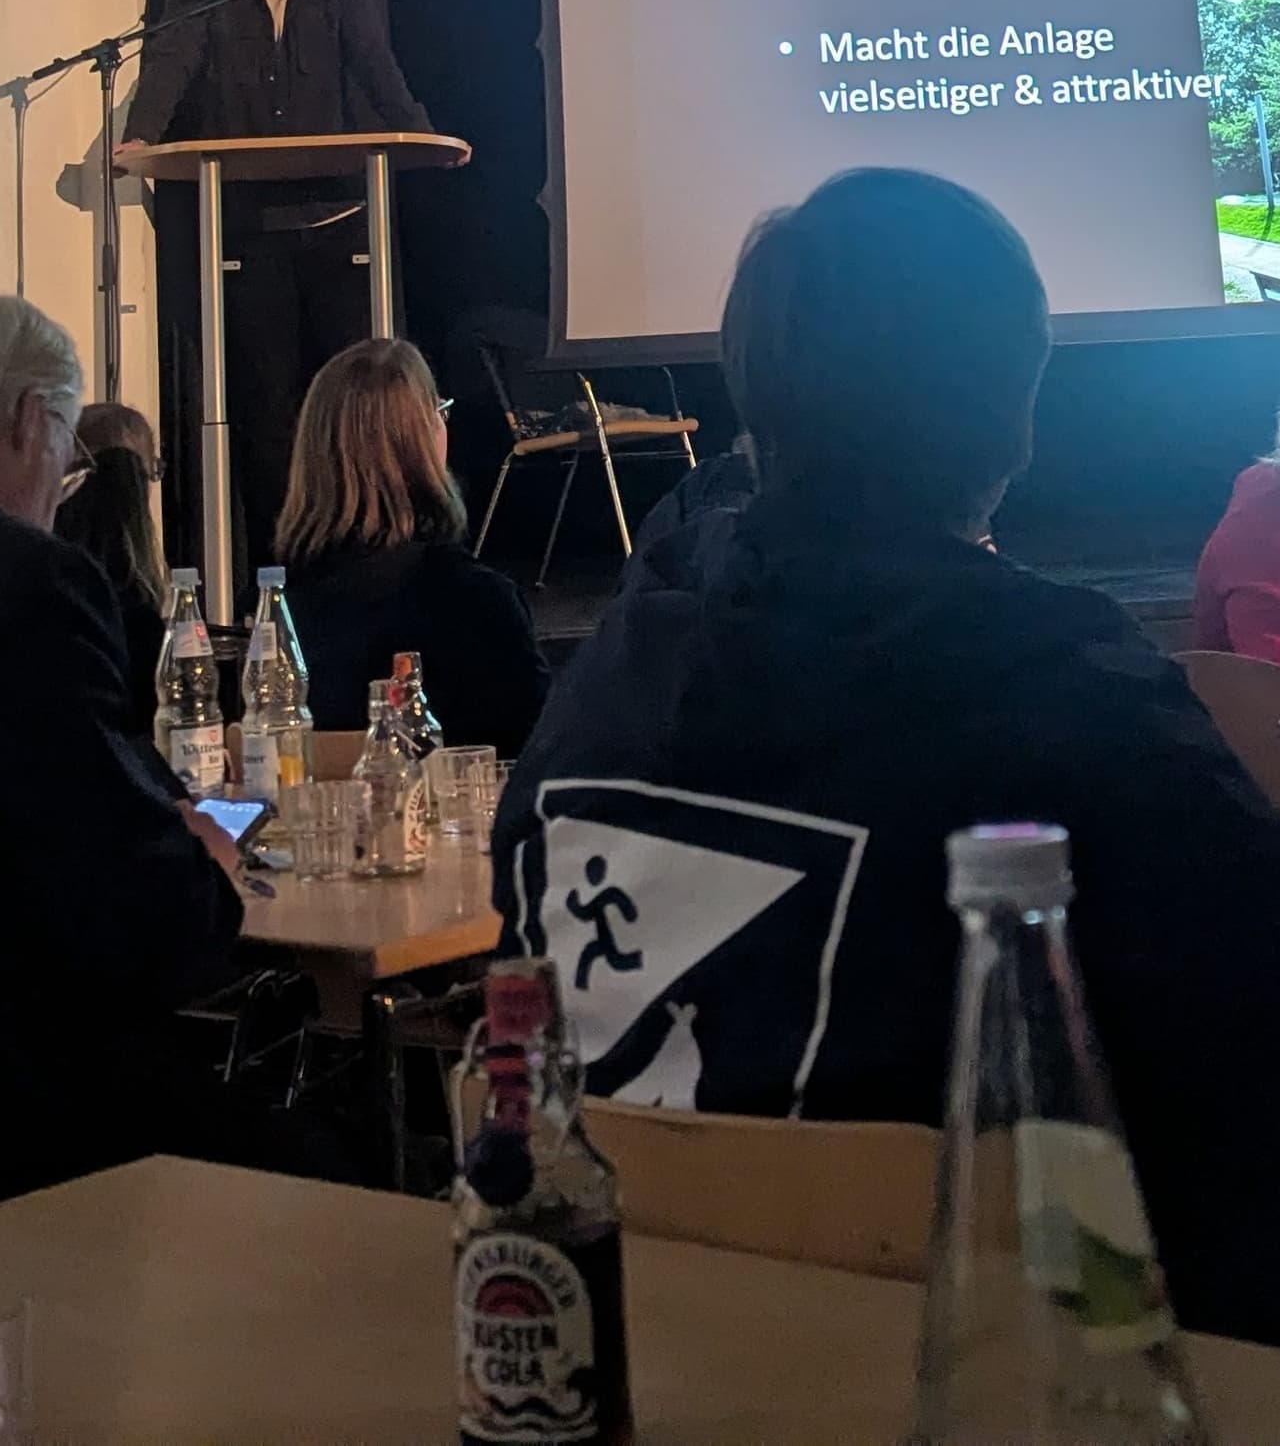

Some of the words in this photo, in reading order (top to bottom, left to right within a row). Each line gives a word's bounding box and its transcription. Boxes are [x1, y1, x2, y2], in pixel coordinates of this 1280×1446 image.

[819, 28, 930, 63] Macht
[938, 26, 990, 58] die
[999, 21, 1114, 60] Anlage
[819, 77, 1005, 115] vielseitiger
[1014, 74, 1043, 106] &
[1052, 67, 1233, 105] attraktiver.
